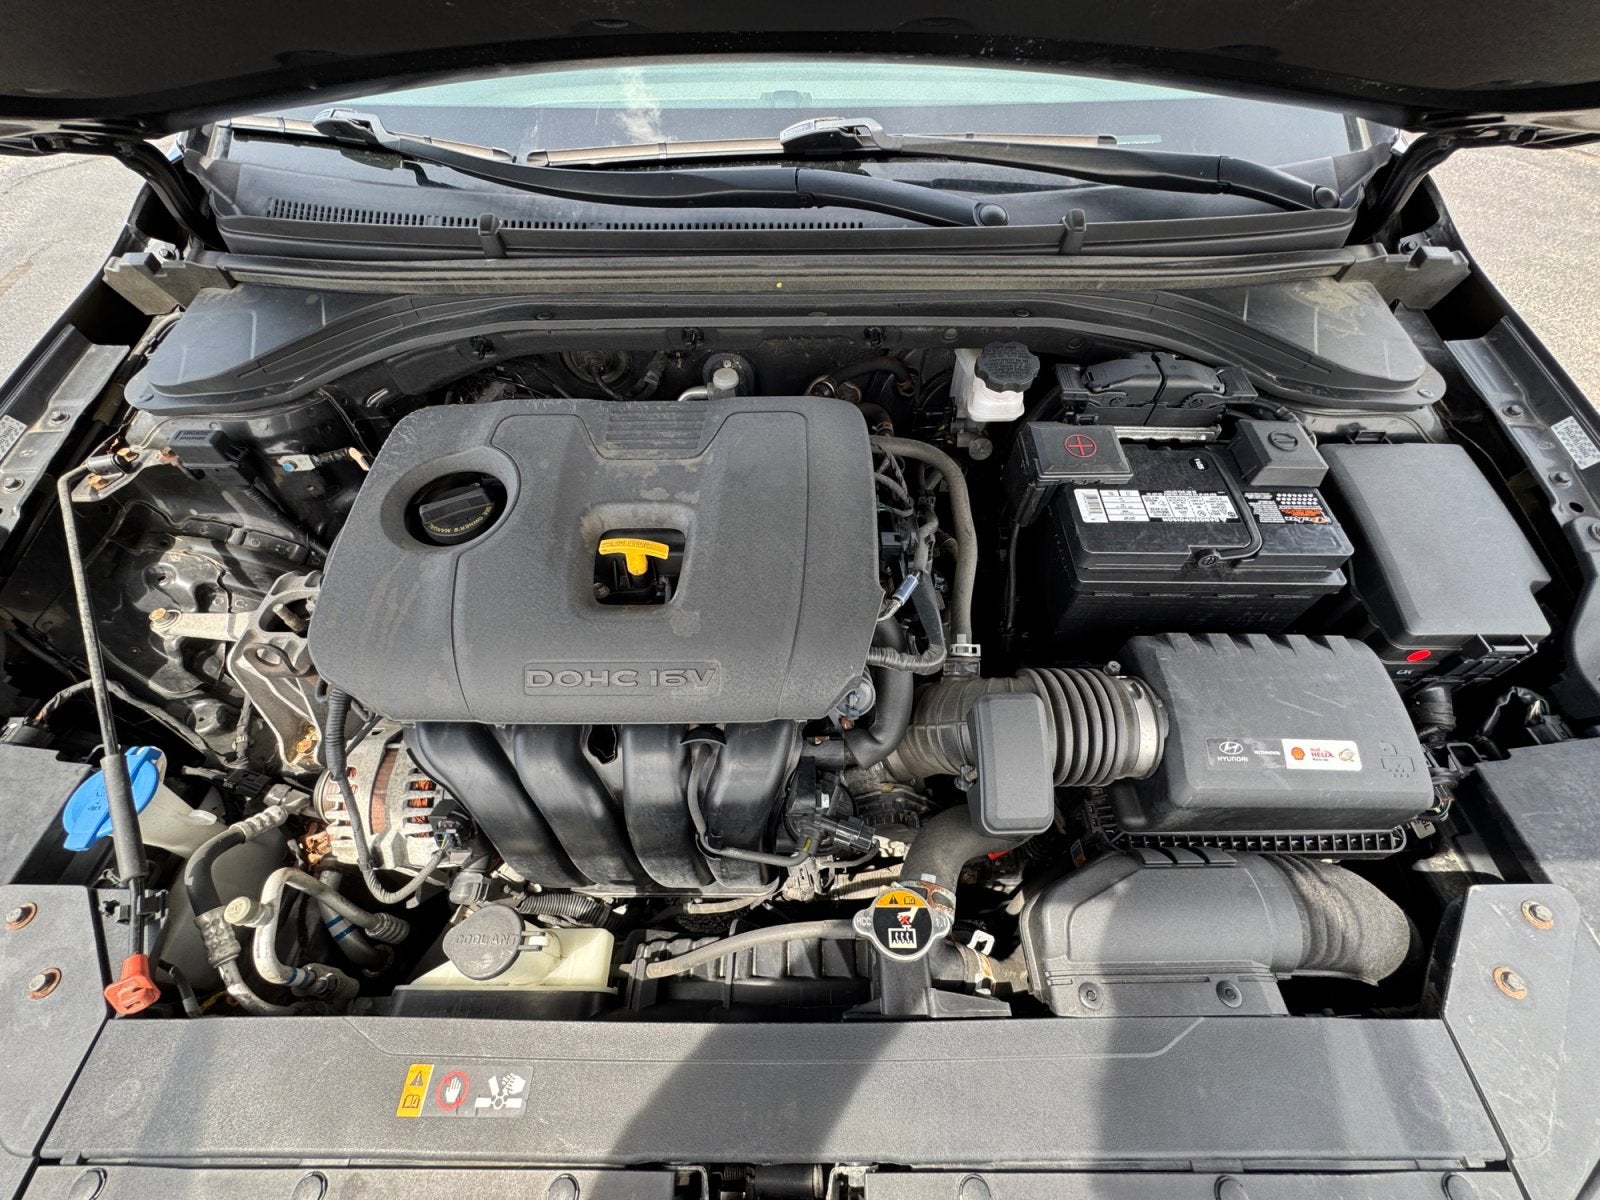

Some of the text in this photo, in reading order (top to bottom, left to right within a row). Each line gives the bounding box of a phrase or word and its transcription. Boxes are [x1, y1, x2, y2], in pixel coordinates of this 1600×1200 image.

[526, 668, 717, 689] DOHC 16V
[1217, 755, 1249, 763] HYUNDAI
[1311, 750, 1335, 758] HELIX
[856, 916, 873, 927] HCC
[456, 933, 519, 946] COOLANT
